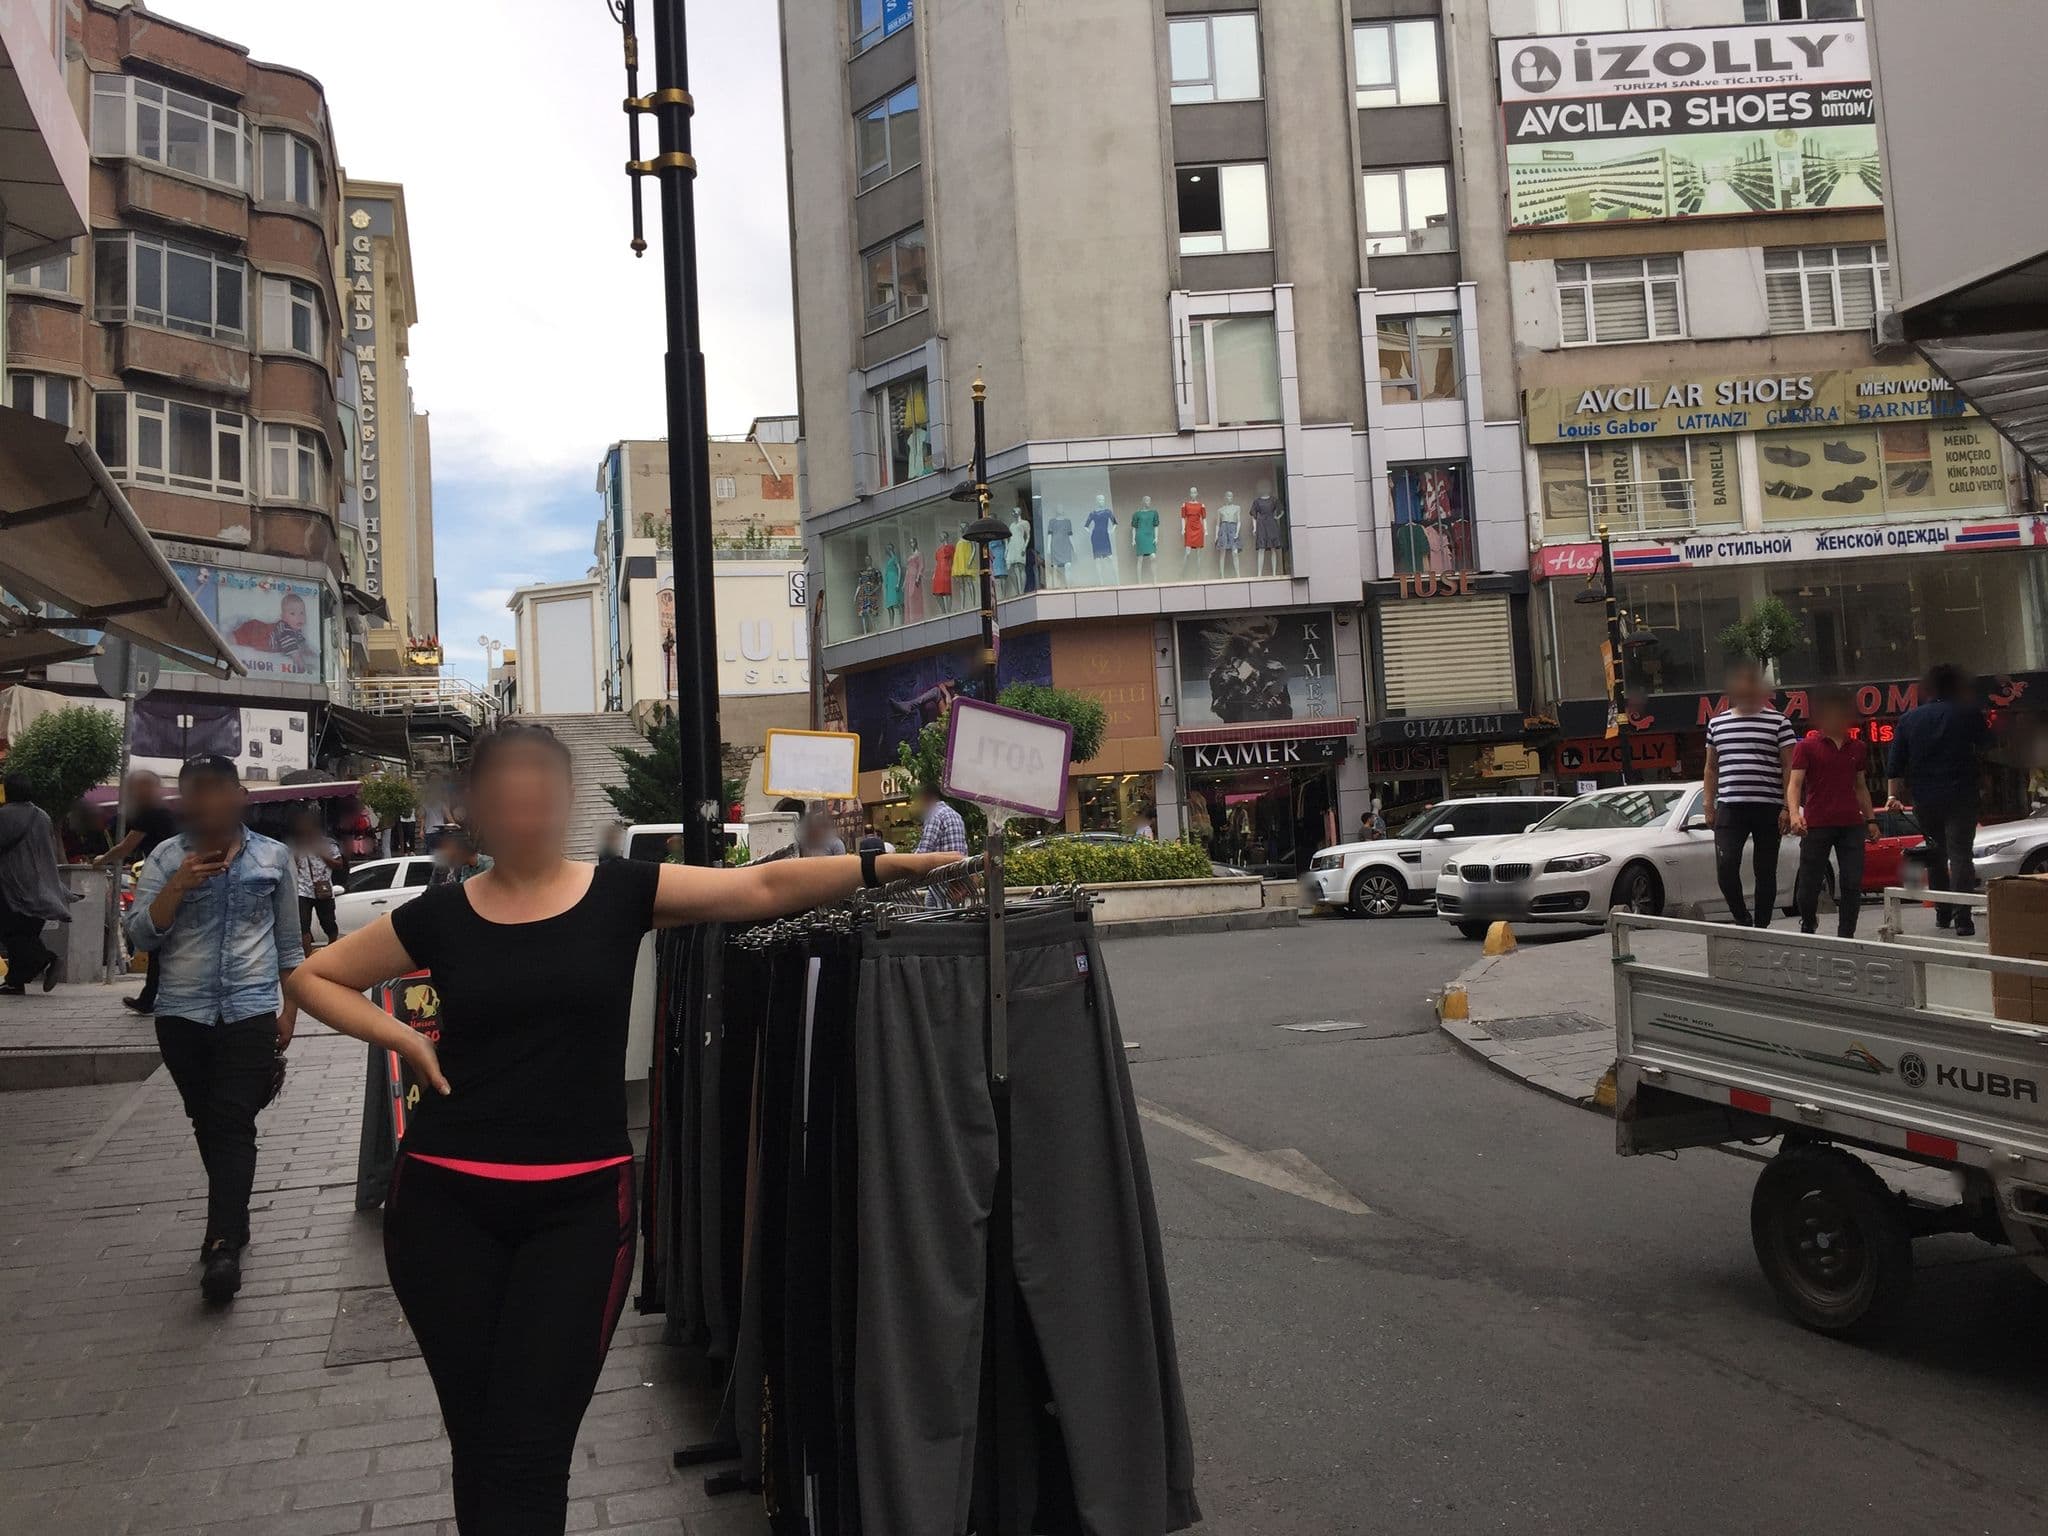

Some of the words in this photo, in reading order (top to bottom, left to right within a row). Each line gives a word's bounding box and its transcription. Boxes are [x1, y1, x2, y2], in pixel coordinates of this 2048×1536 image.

[1516, 100, 1672, 136] AVCILAR
[1686, 91, 1813, 126] SHOES
[353, 235, 373, 331] GRAND
[1576, 384, 1703, 415] AVCILAR
[1717, 376, 1815, 406] SHOES
[356, 345, 377, 502] MARCELLO
[1558, 421, 1601, 438] Louis
[1606, 417, 1658, 435] Gabor
[1677, 411, 1747, 430] LATTANZI
[1766, 405, 1840, 426] GUERRA
[1944, 434, 1981, 446] MENDL
[1969, 464, 1998, 476] PAOLO
[1949, 480, 1976, 493] CARLO
[1977, 478, 2003, 491] VENTO
[1685, 545, 1713, 560] МИР
[1718, 536, 1792, 557] СТИЛЬНОЙ
[1816, 530, 1883, 551] ЖЕНСКОЙ
[1887, 527, 1949, 547] ОДЕЖДЫ
[1403, 717, 1503, 738] GIZZELLI
[1195, 740, 1300, 768] KAMER
[1936, 1064, 2038, 1103] KUBA
